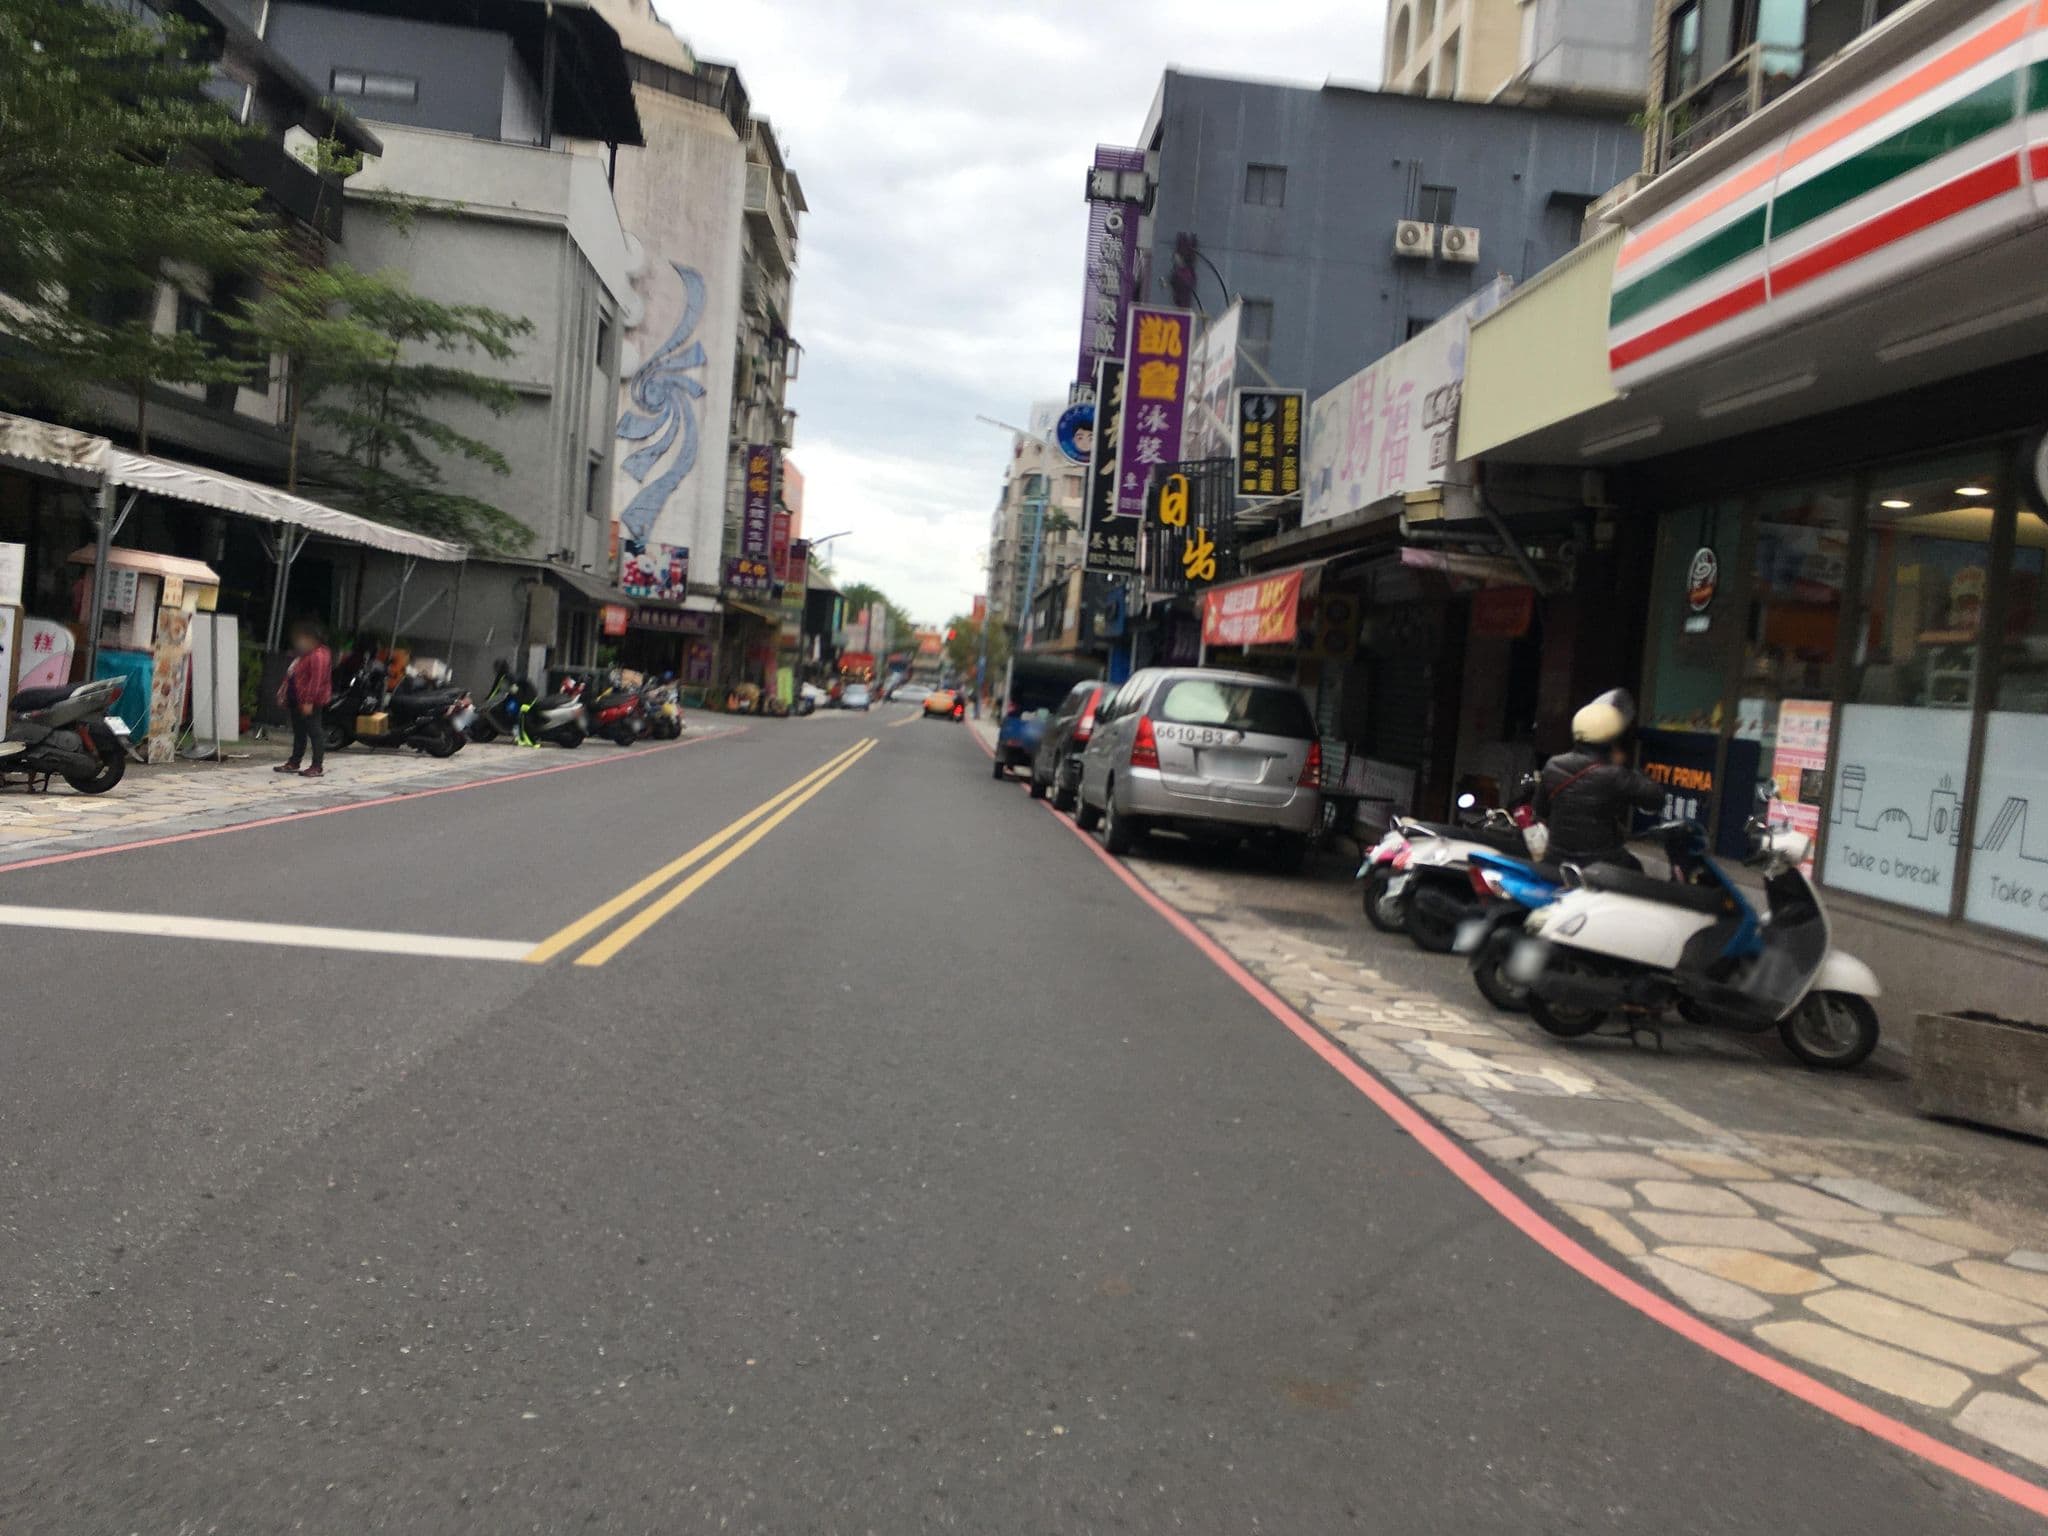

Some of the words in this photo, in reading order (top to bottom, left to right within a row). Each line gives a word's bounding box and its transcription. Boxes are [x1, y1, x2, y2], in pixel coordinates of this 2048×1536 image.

[1672, 766, 1712, 792] PRIMA
[1843, 845, 1875, 873] Take
[1894, 857, 1941, 886] break
[1991, 875, 2032, 908] Take
